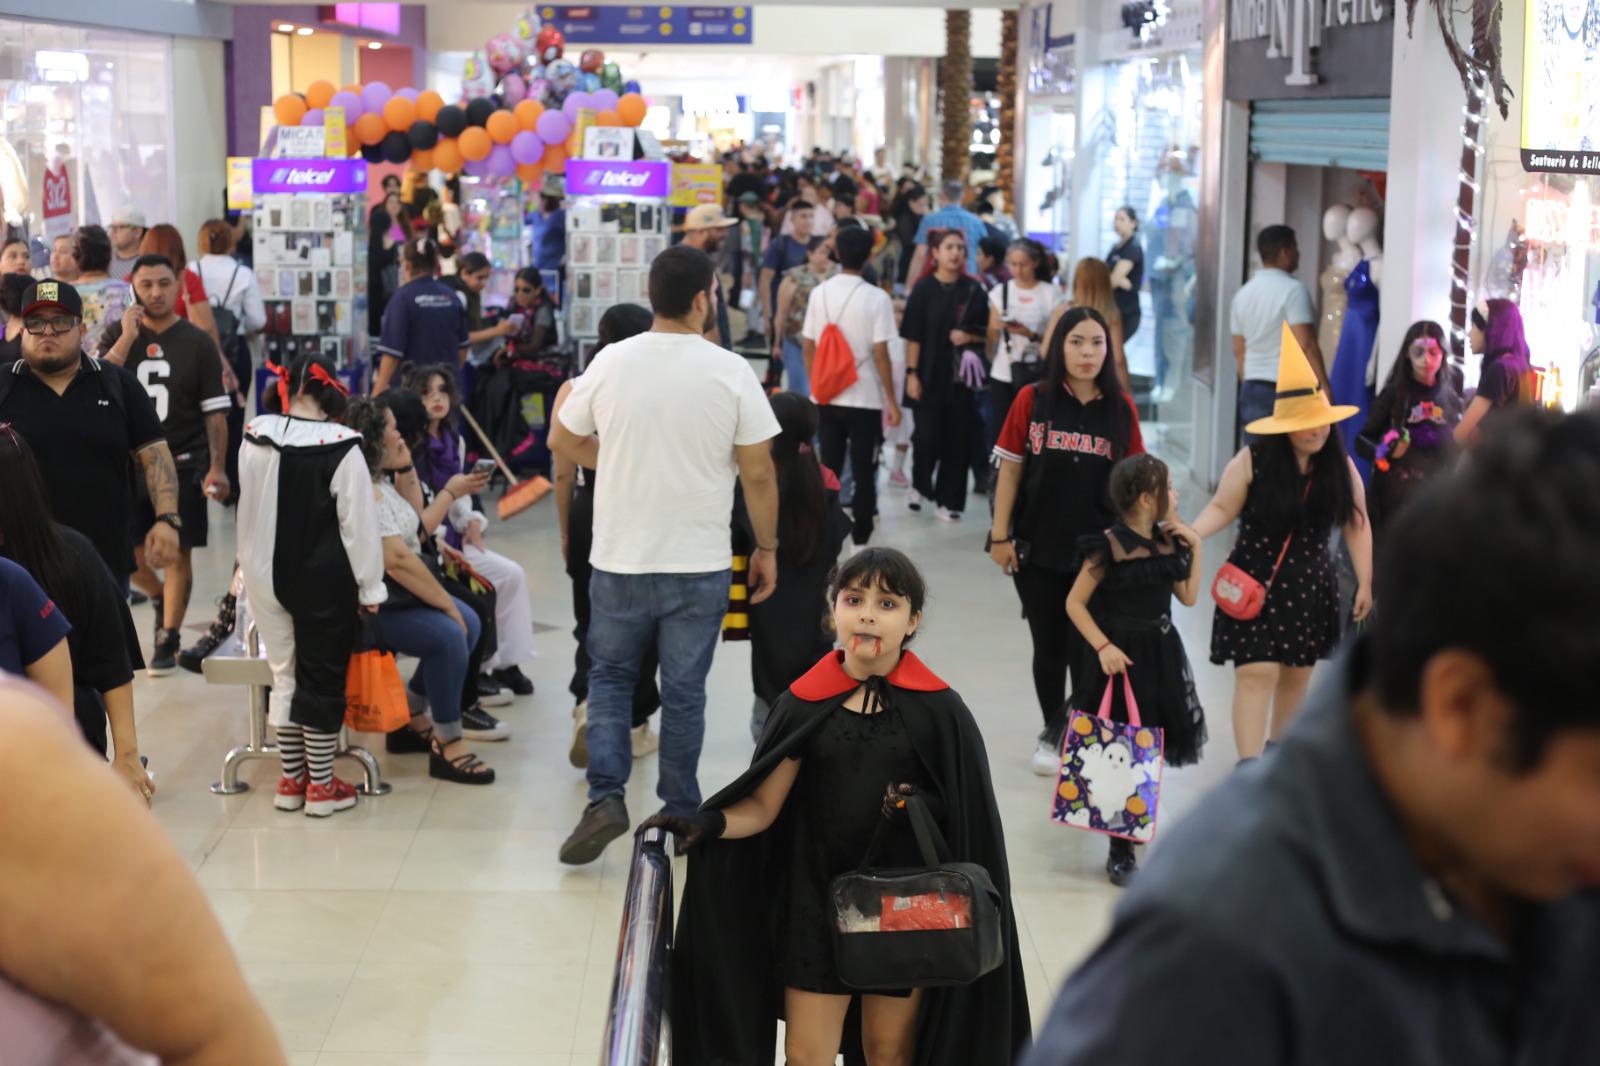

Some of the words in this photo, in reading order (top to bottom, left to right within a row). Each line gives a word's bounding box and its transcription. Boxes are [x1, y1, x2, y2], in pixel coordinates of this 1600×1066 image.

[1530, 153, 1567, 168] Santuario
[1569, 155, 1579, 168] de
[286, 167, 335, 185] telcel
[601, 169, 651, 187] telcel
[137, 359, 171, 423] 6
